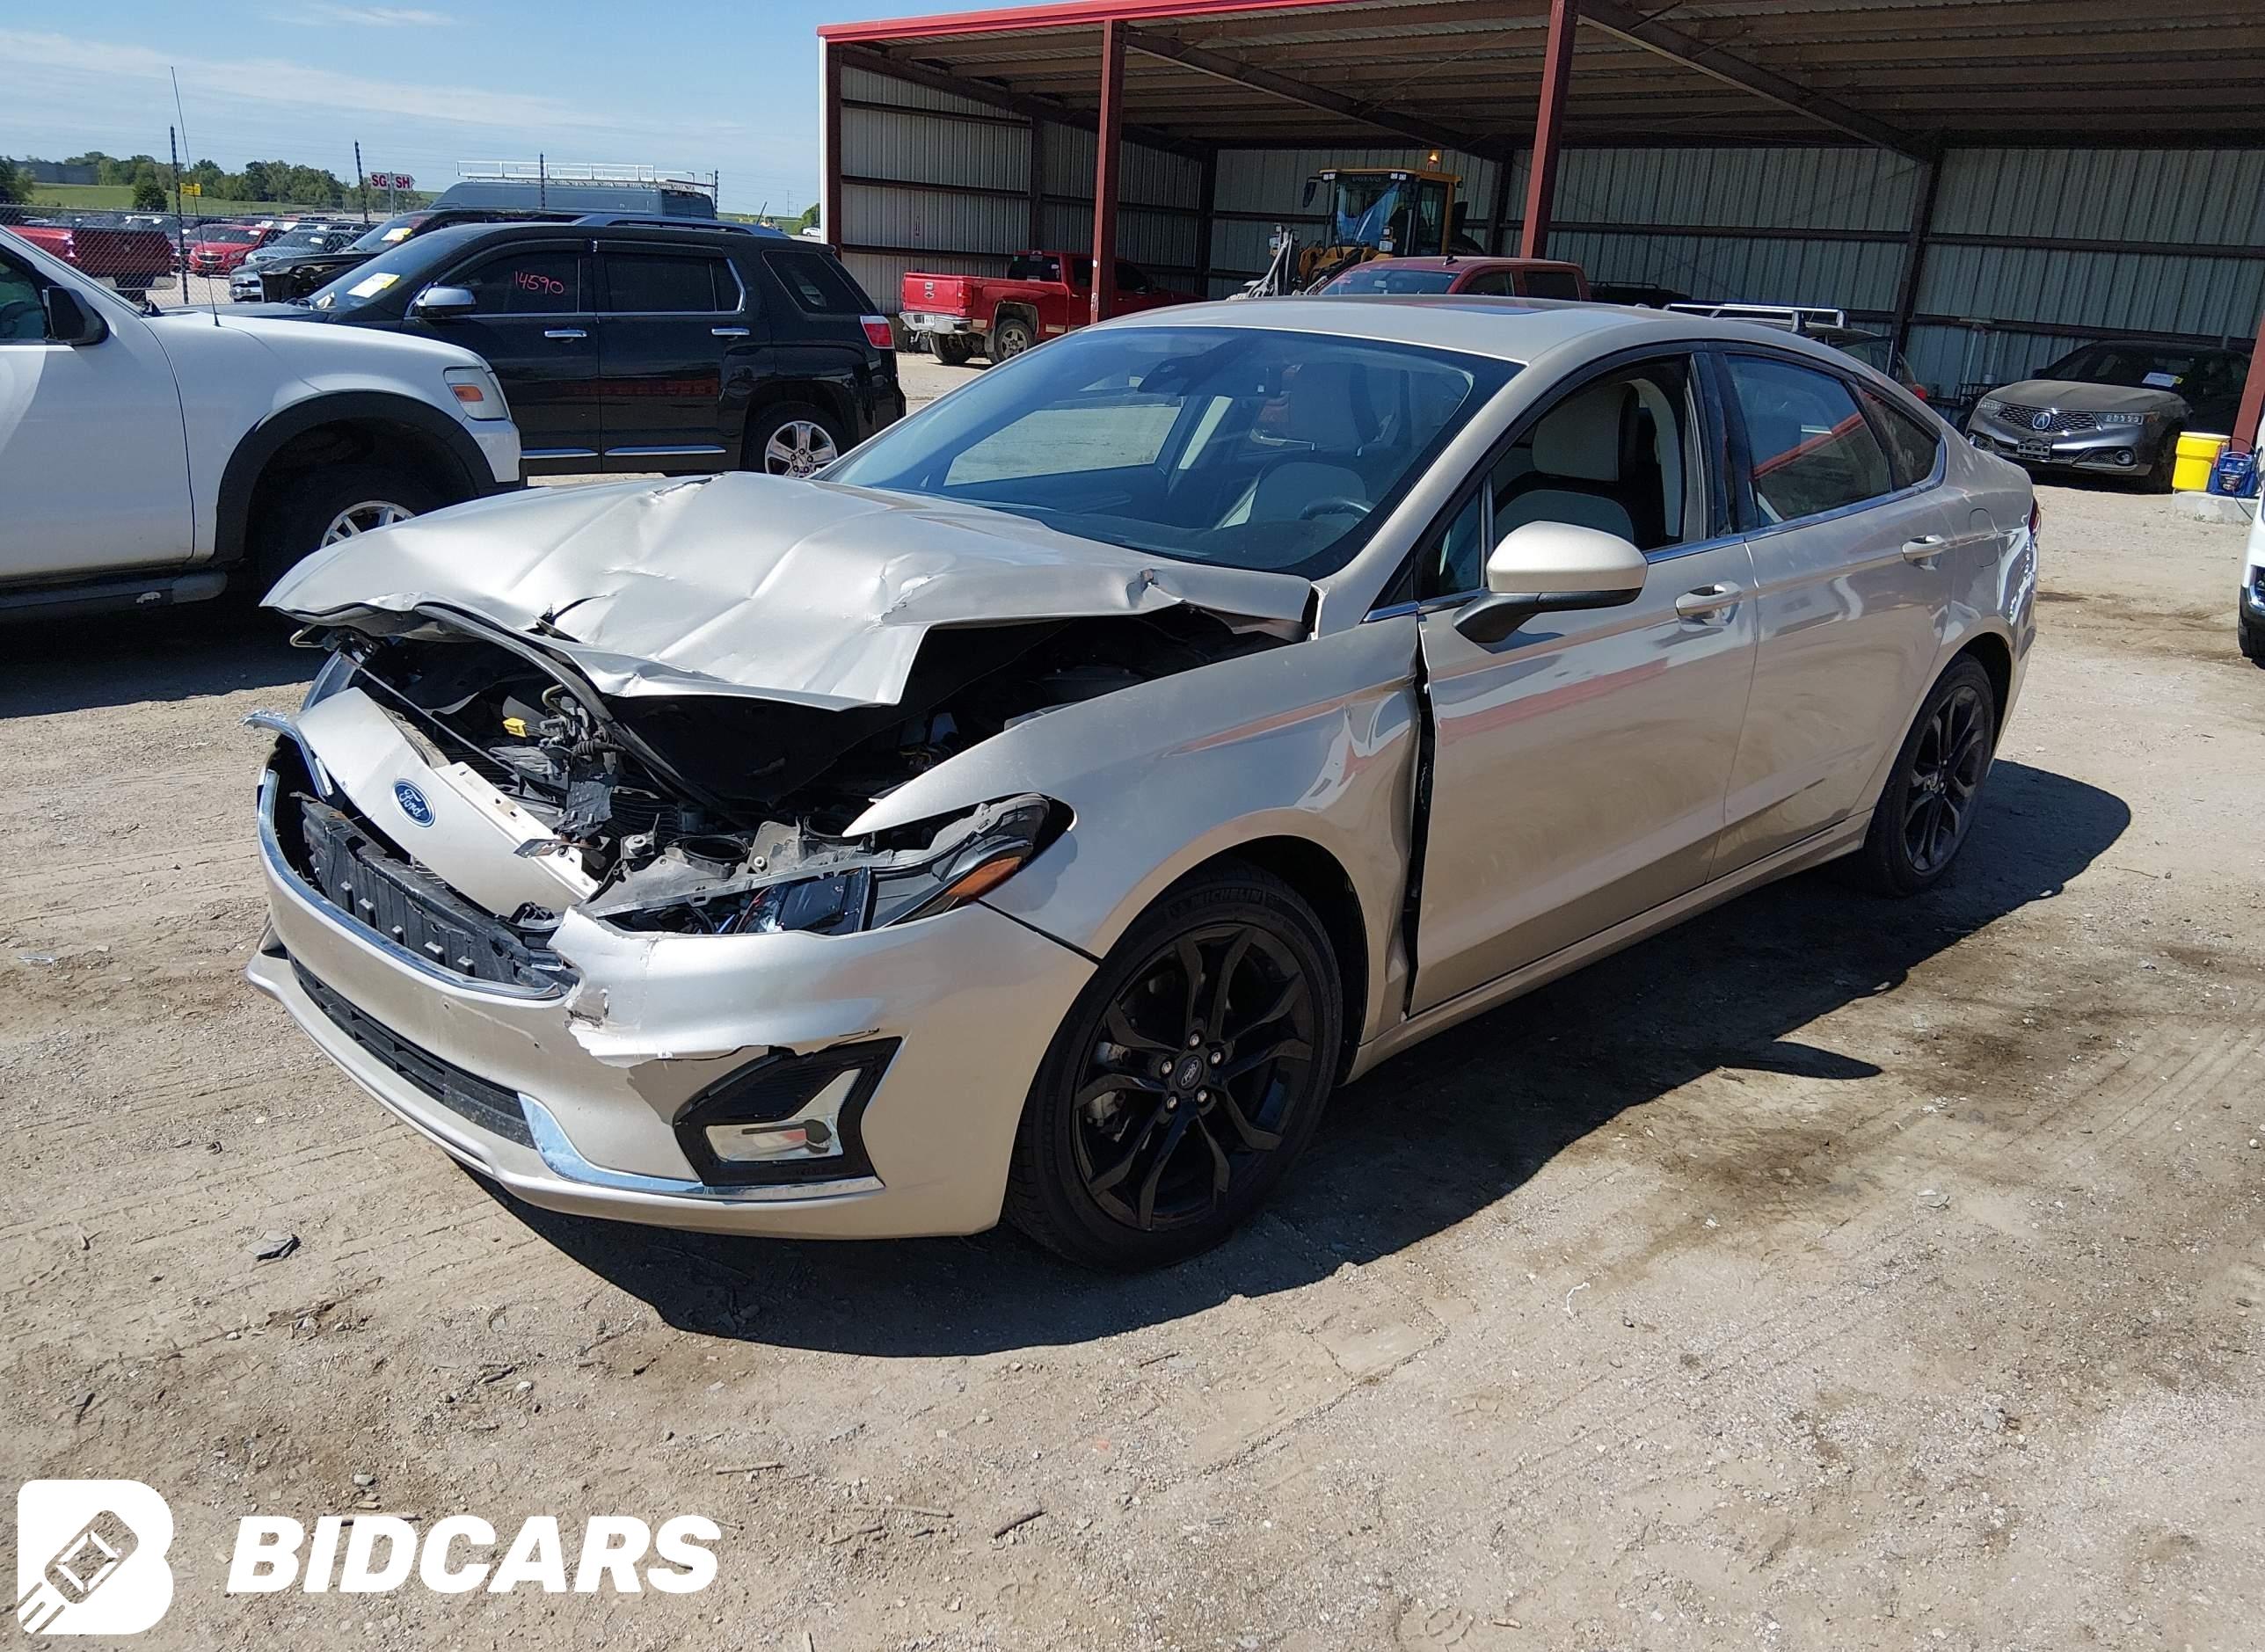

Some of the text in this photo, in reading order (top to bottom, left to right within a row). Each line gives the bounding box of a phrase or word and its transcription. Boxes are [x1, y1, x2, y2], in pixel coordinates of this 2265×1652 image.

[371, 174, 387, 186] SG
[396, 176, 411, 188] SH
[514, 270, 564, 295] 14590
[398, 789, 426, 818] Ford
